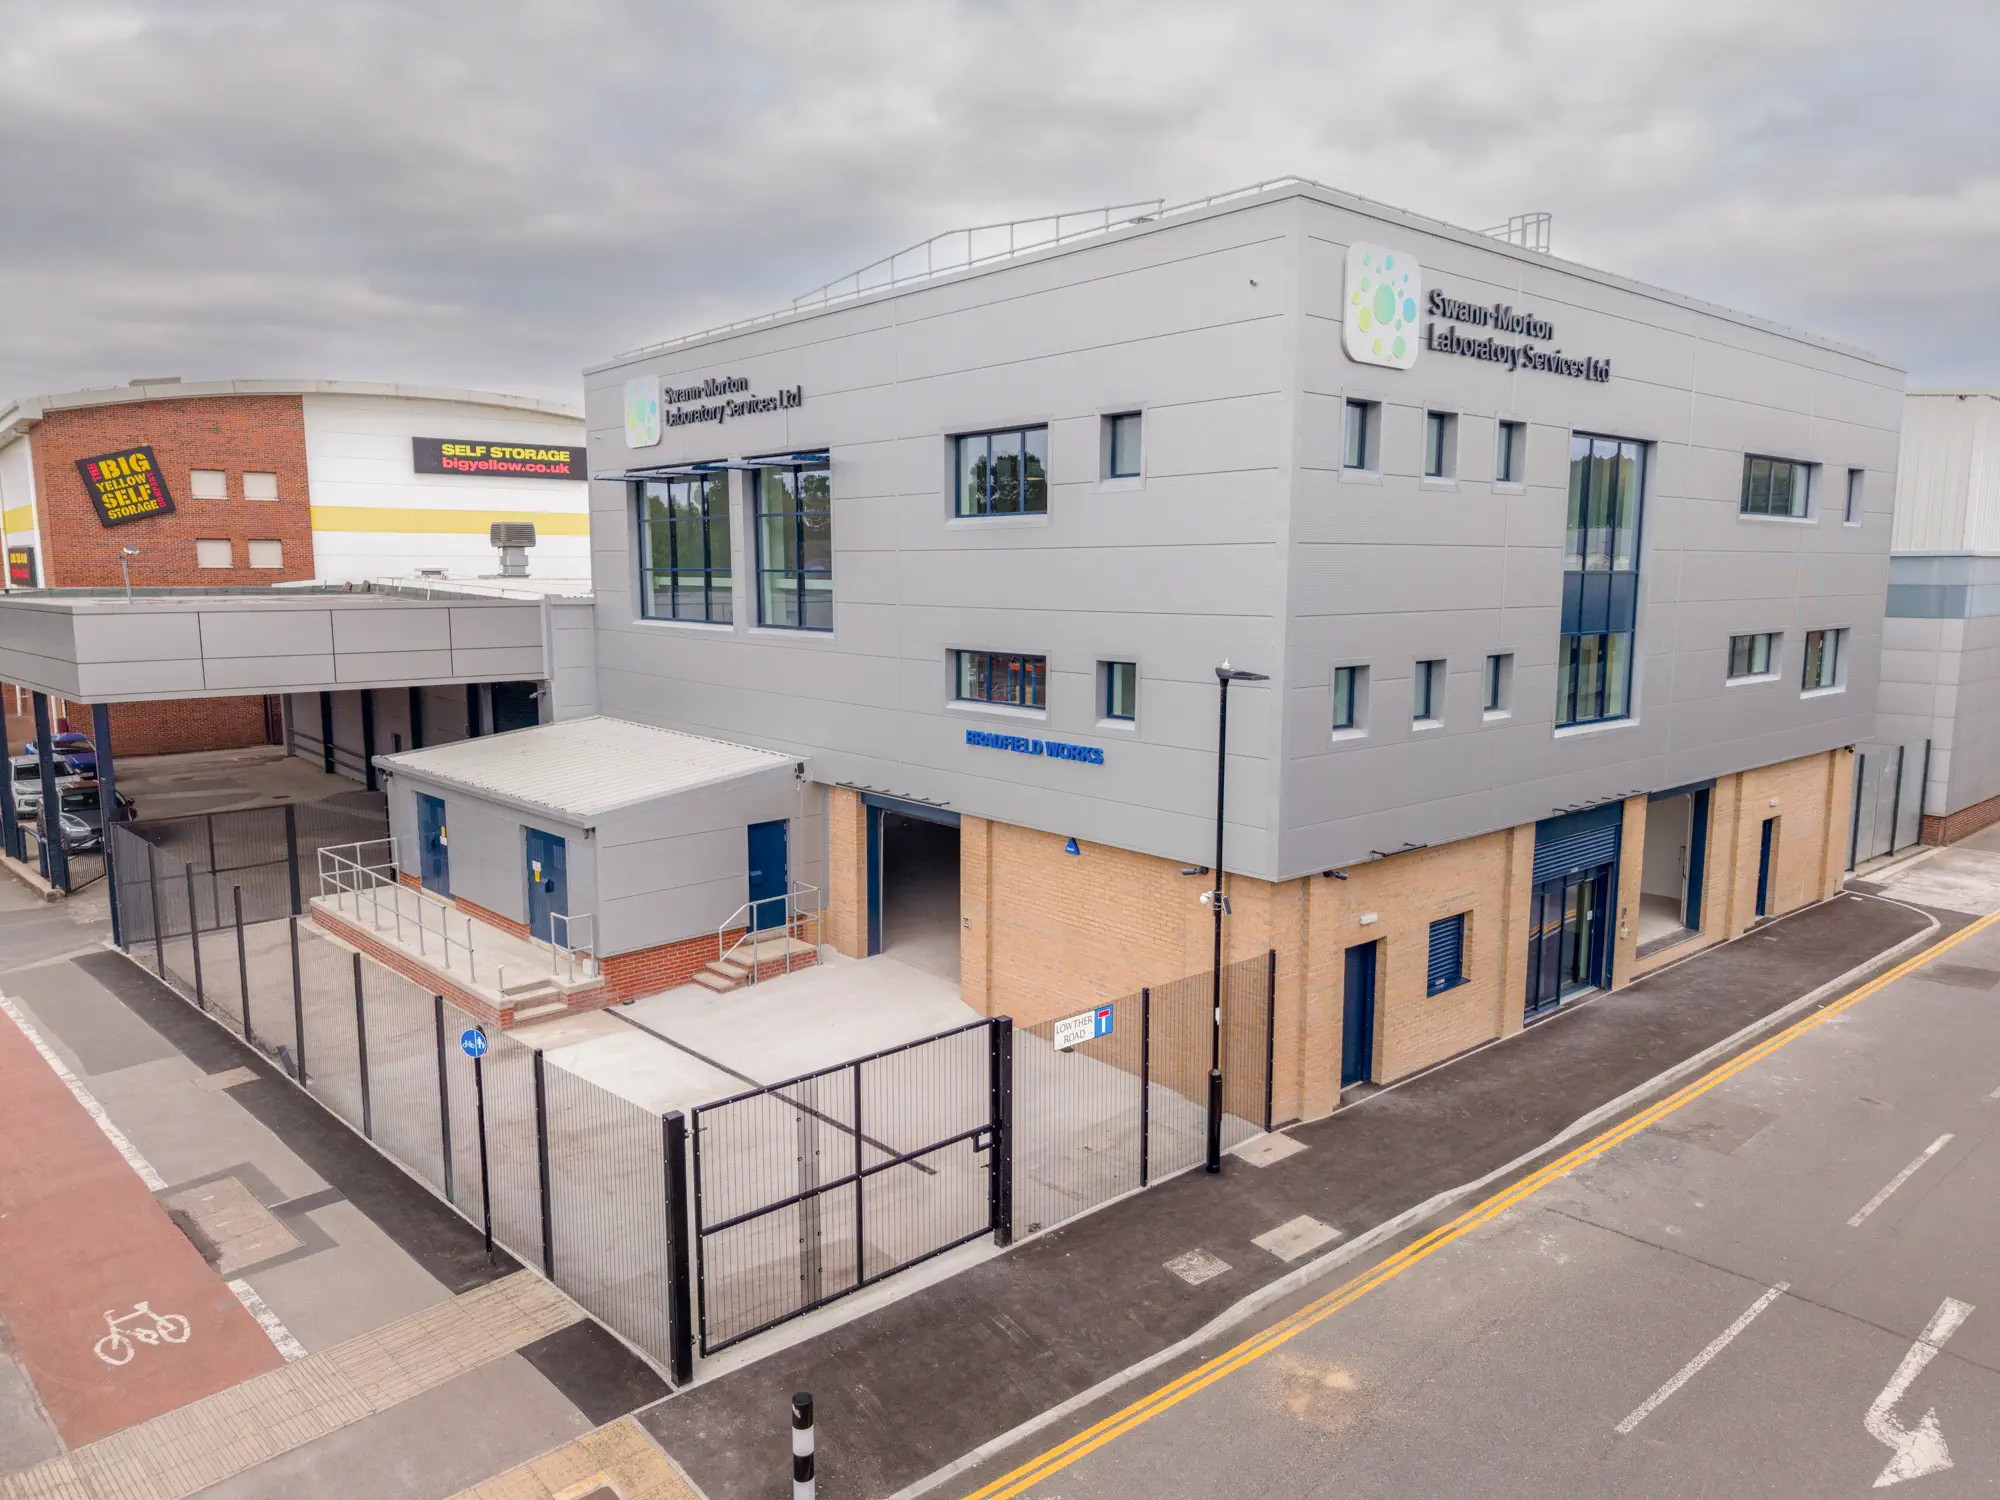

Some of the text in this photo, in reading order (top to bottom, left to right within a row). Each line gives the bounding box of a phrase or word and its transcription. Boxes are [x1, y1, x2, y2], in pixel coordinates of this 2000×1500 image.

[1428, 288, 1555, 341] Swann-Morton
[1427, 322, 1611, 383] Laboratory Services Ltd
[664, 376, 749, 405] Swann-Morton
[665, 385, 802, 427] Laboratory Services Ltd
[441, 443, 570, 462] SELF STORAGE
[442, 457, 570, 474] bigyellow.co.uk
[98, 453, 151, 480] BIG
[96, 473, 147, 493] YELLOW
[101, 483, 152, 509] SELF
[107, 499, 159, 519] STORAGE
[966, 729, 1105, 765] BRADFIELD WORKS
[1056, 1015, 1093, 1035] LOWTHER
[1063, 1029, 1086, 1044] ROAD
